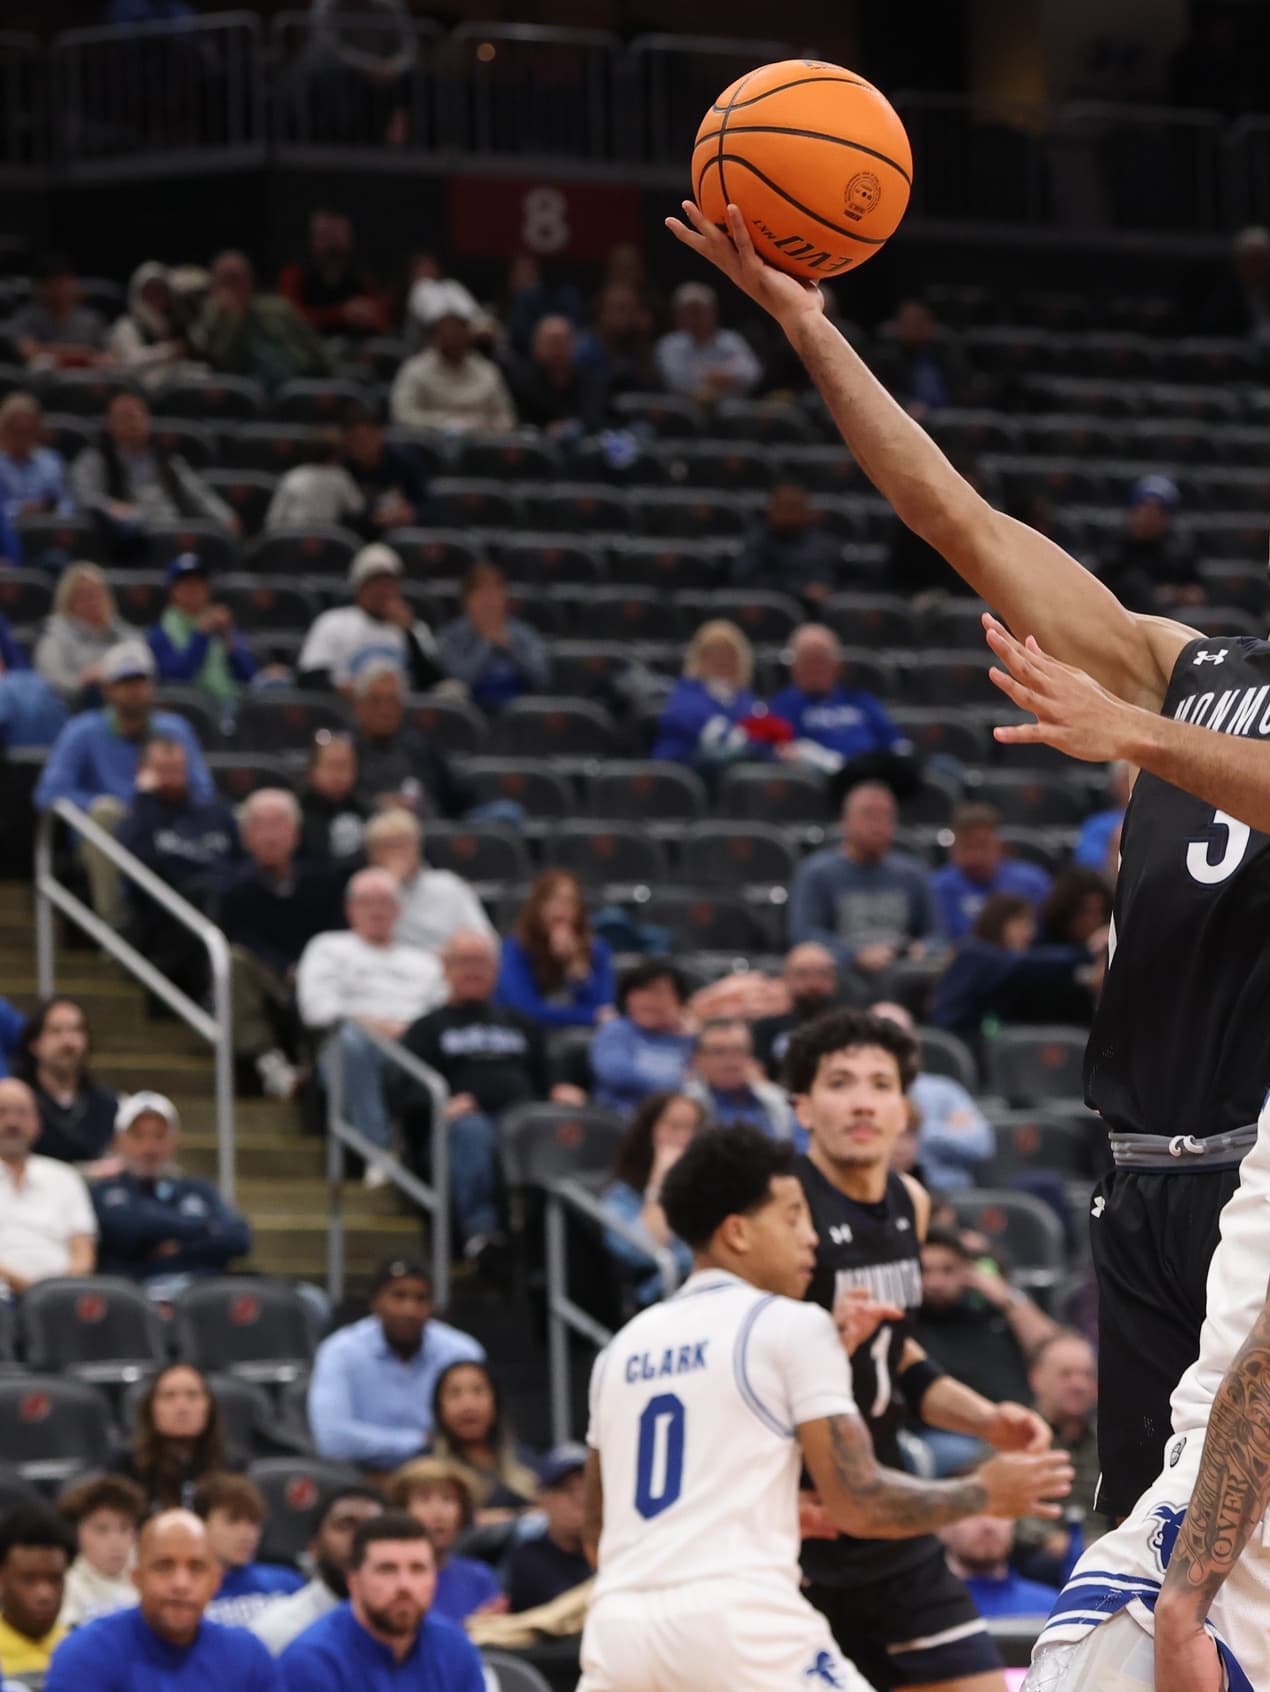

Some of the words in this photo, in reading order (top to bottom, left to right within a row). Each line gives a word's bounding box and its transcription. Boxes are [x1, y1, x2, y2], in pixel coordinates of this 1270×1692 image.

[522, 187, 569, 253] 8
[752, 219, 777, 239] NXT
[774, 235, 853, 272] EVO
[625, 1340, 709, 1384] CLARK
[870, 1325, 893, 1418] 1
[634, 1393, 686, 1521] 0
[1213, 1476, 1250, 1558] OVER
